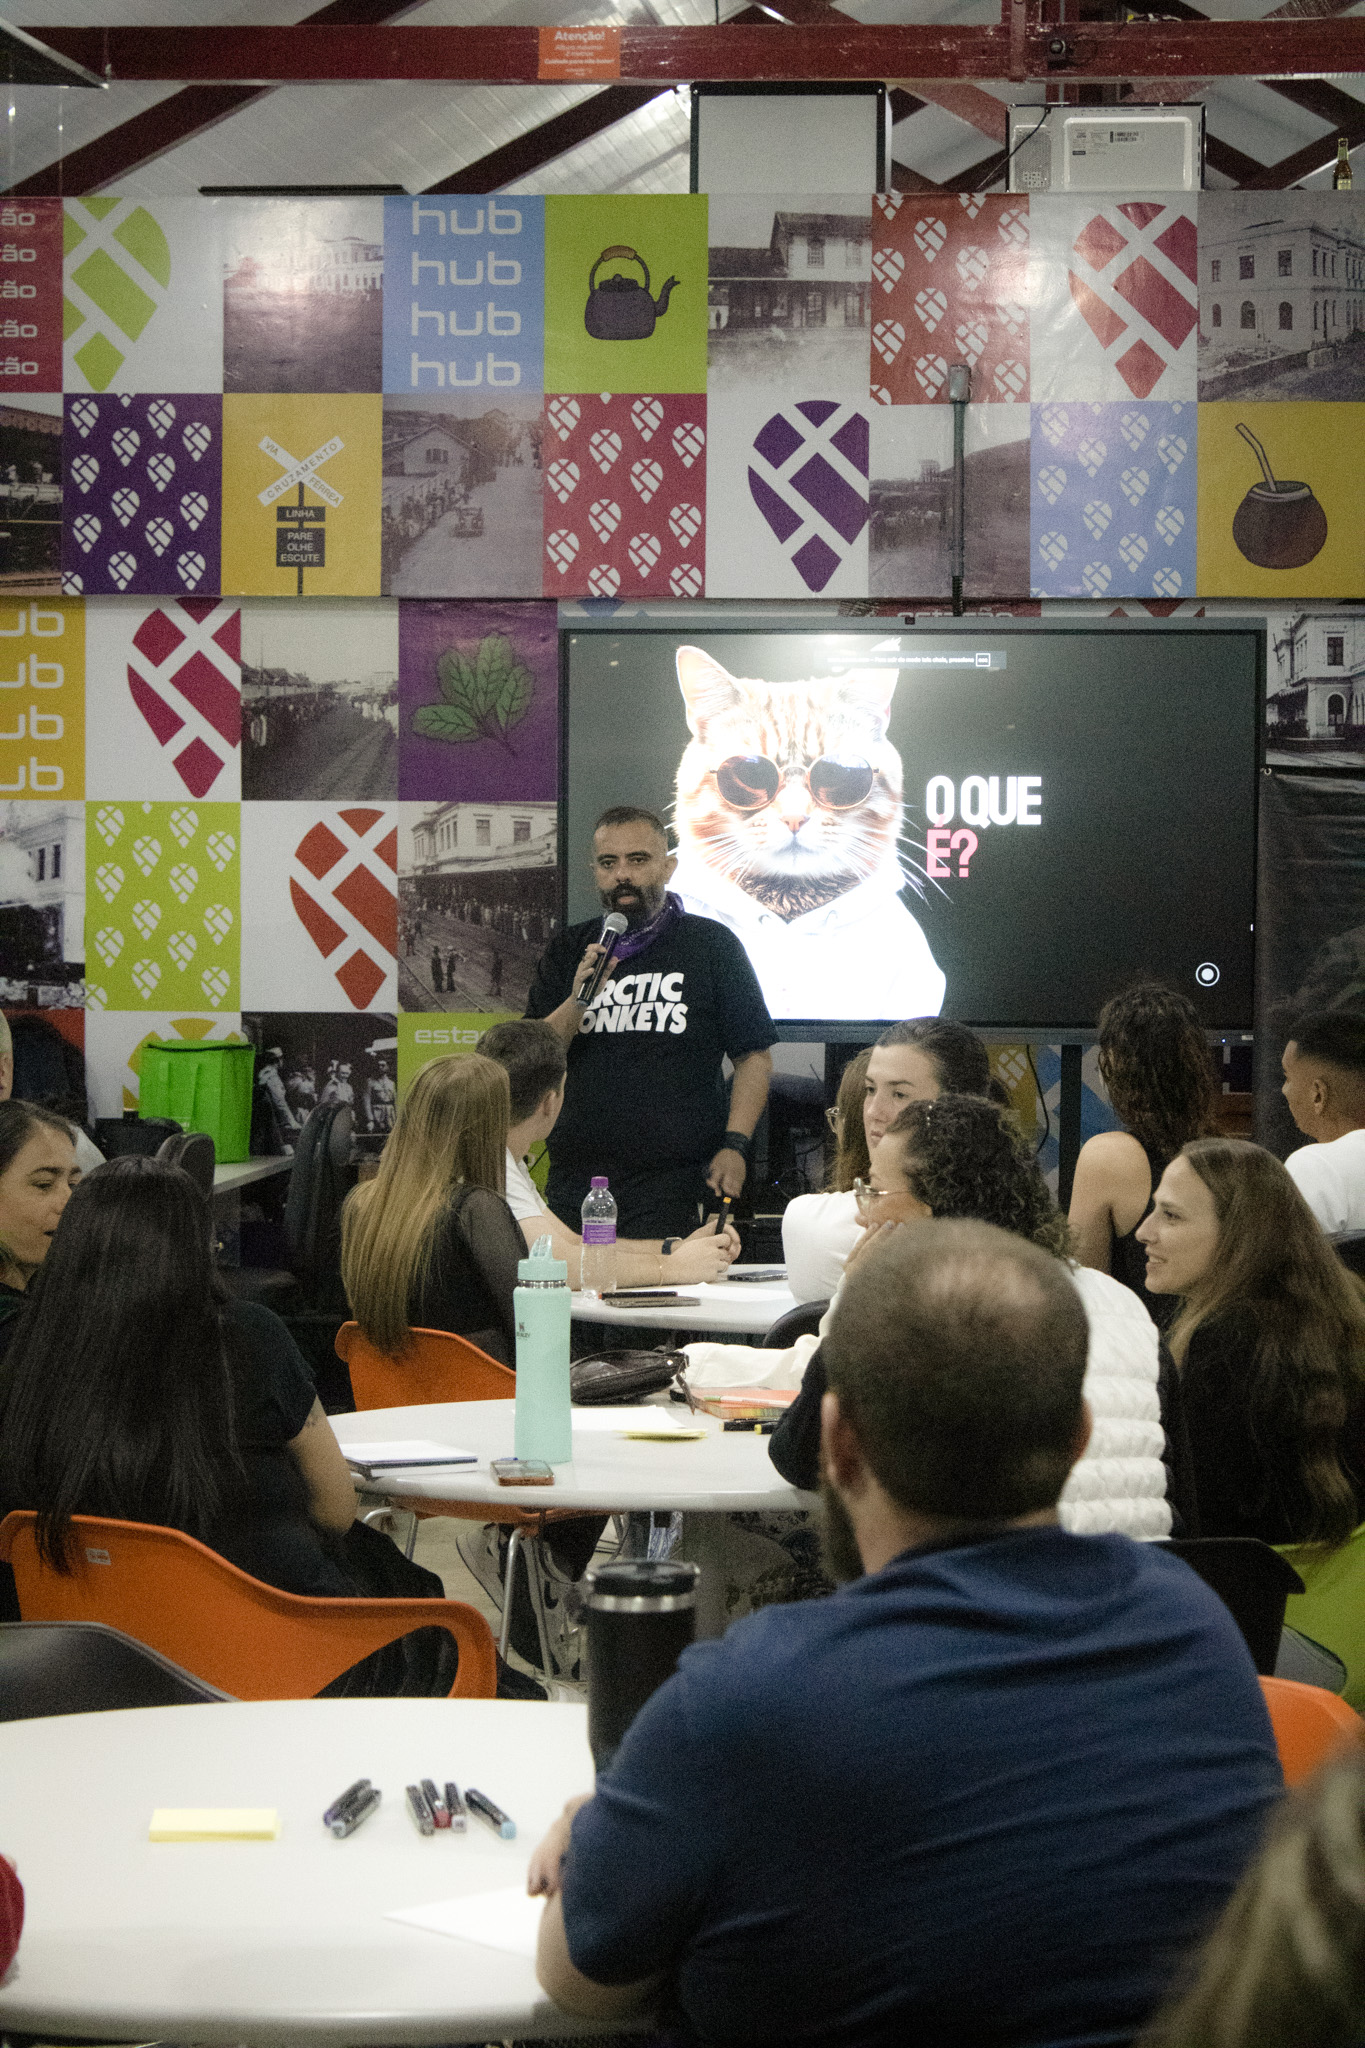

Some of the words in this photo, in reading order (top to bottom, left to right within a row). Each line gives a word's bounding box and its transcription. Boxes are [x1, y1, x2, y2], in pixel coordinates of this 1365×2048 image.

[554, 30, 606, 43] Atenção!
[0, 208, 35, 226] ão
[412, 200, 523, 235] hub
[0, 244, 37, 262] ão
[411, 251, 522, 285] hub
[0, 280, 37, 298] ão
[0, 319, 38, 338] ão
[411, 302, 521, 336] hub
[0, 356, 39, 375] ão
[411, 352, 521, 386] hub
[265, 442, 279, 456] VIA
[267, 442, 338, 498] CRUZAMENTO
[286, 509, 315, 518] LINHA
[287, 532, 313, 540] PARE
[287, 542, 314, 551] OLHE
[281, 553, 320, 562] ESCUTE
[926, 775, 955, 825] O
[960, 775, 1042, 829] QUE
[926, 813, 978, 877] É?
[587, 972, 684, 1010] RCTIC
[578, 1002, 688, 1034] ONKEYS
[414, 1026, 487, 1044] esta
